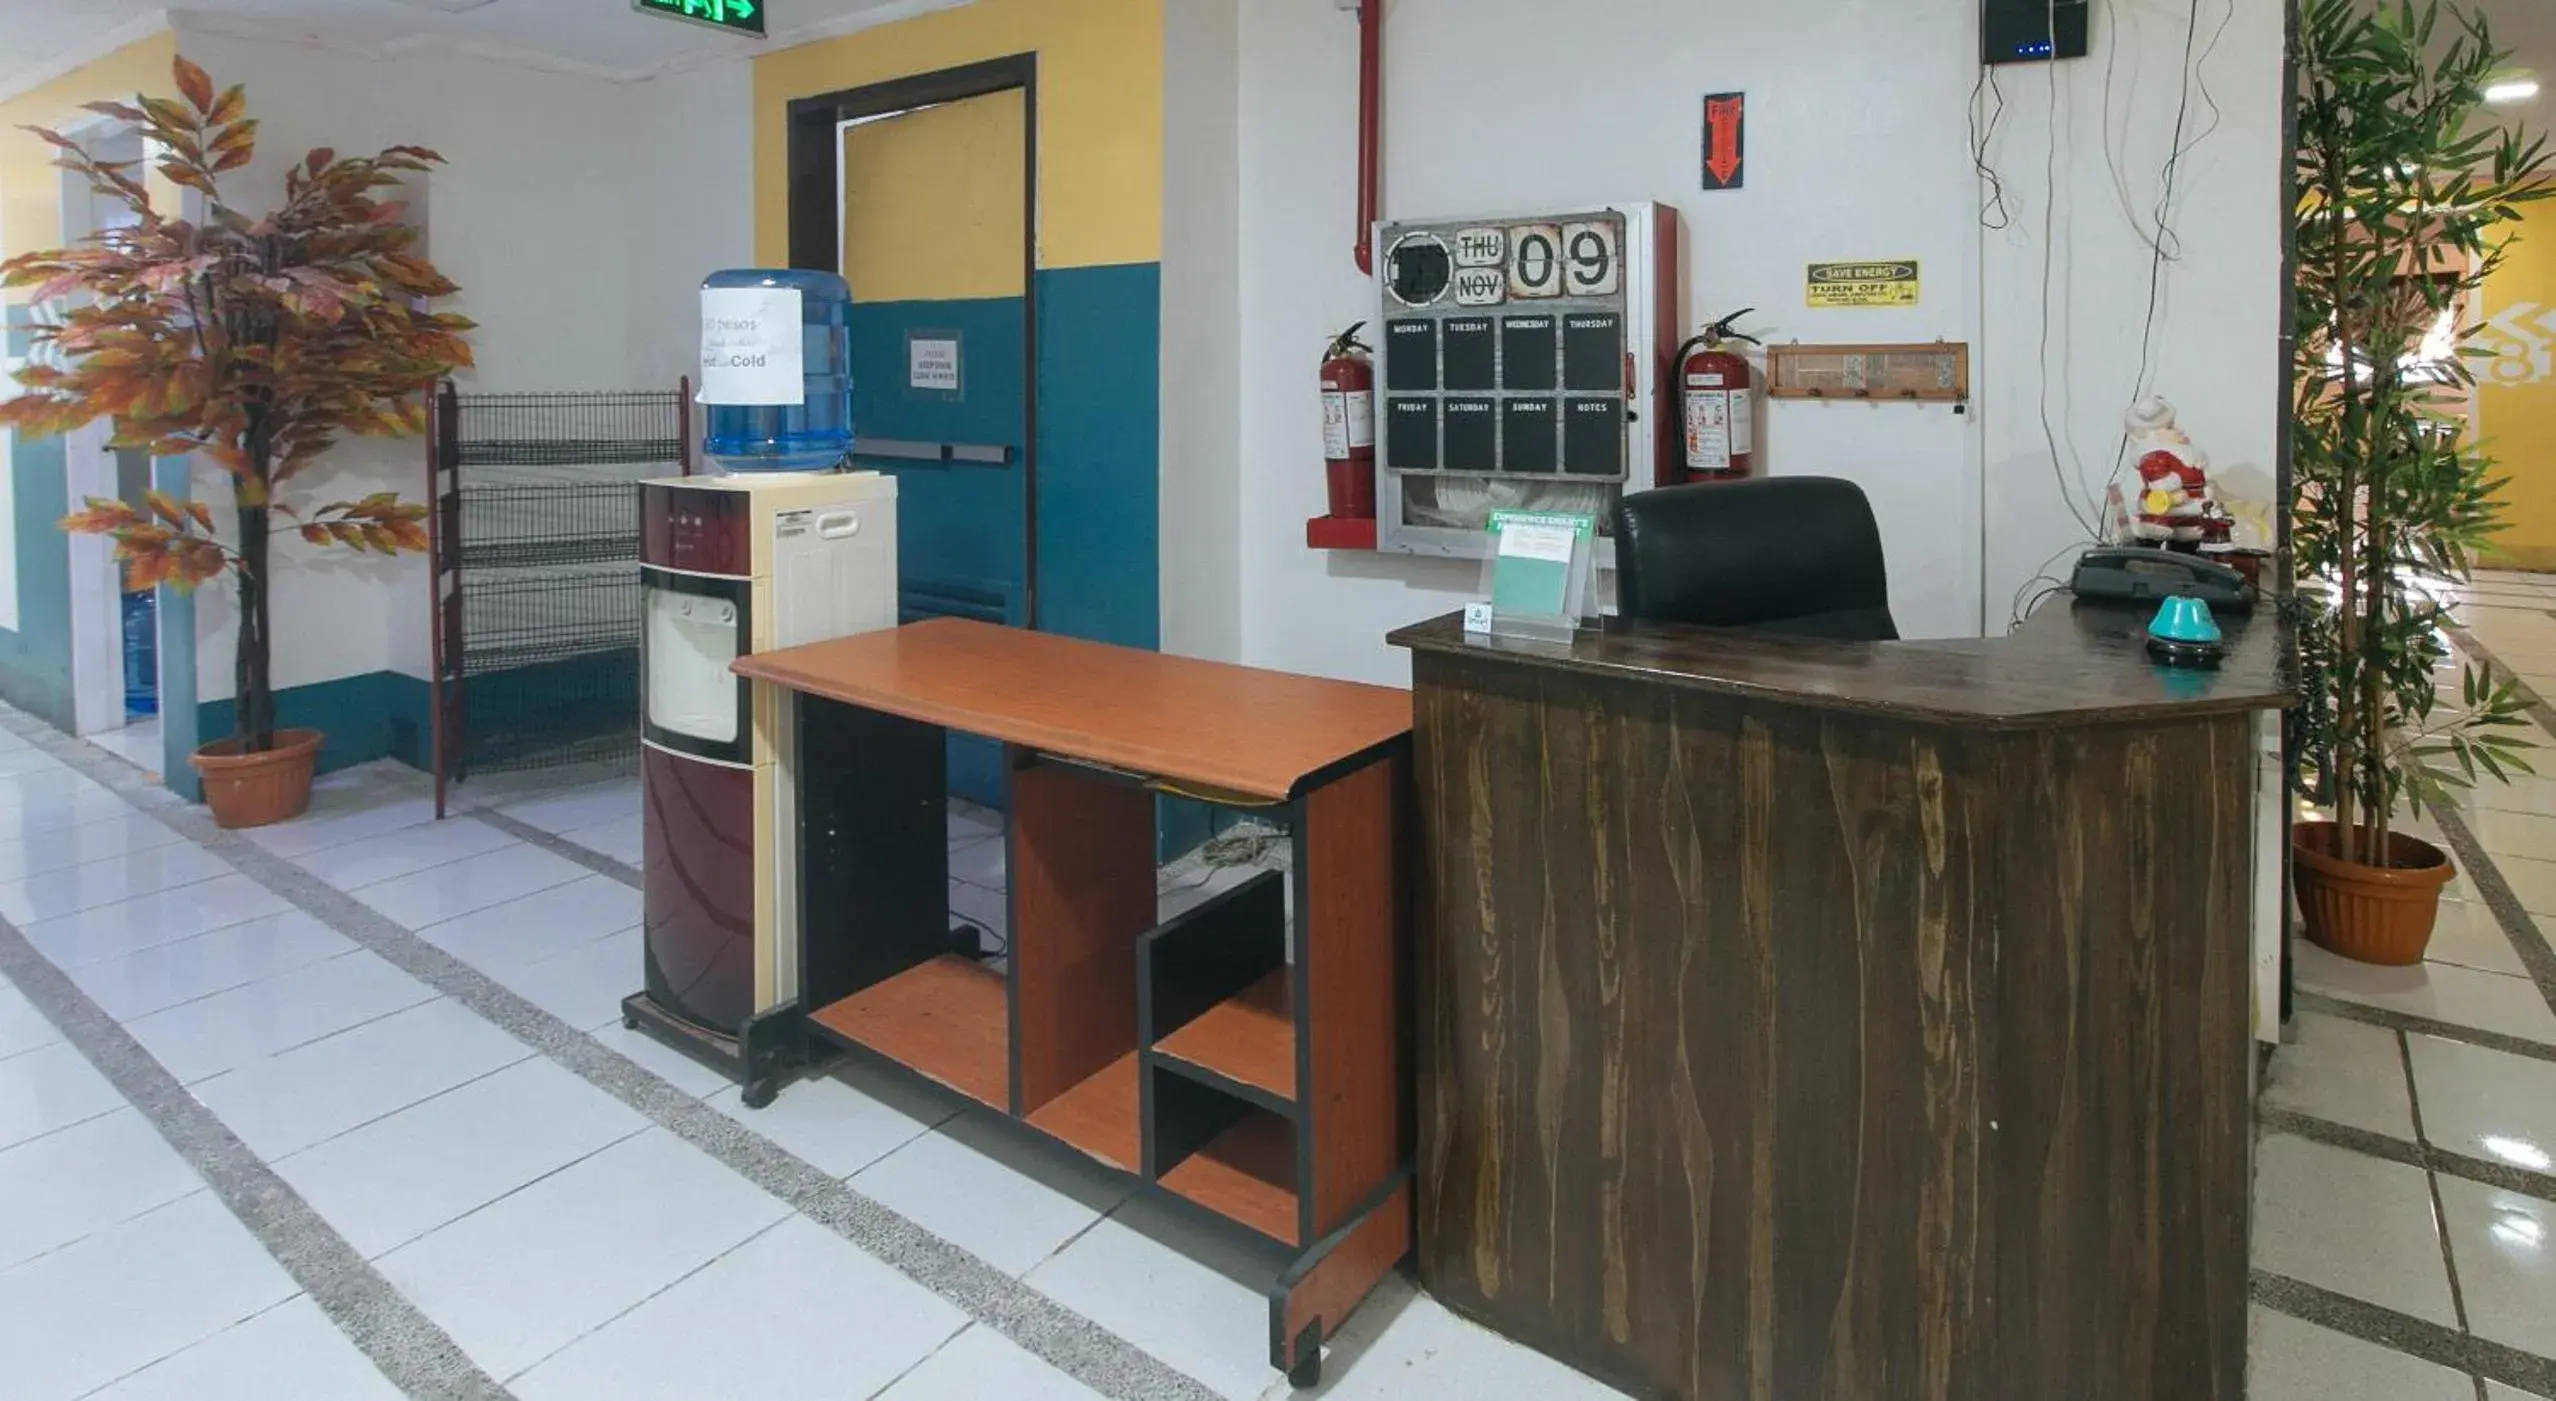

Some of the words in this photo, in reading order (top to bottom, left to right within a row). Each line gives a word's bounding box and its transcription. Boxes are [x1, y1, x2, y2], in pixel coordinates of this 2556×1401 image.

[1461, 235, 1499, 258] THU
[1826, 267, 1852, 279] SAVE
[1855, 265, 1896, 279] ENERGY
[1460, 275, 1499, 296] NOV
[1811, 285, 1854, 293] TURN
[1859, 284, 1888, 293] OFF
[1450, 323, 1488, 332] TUESDAY
[1506, 320, 1549, 329] WEDNESDAY
[1570, 319, 1613, 328] THURSDAY
[1394, 324, 1428, 333] MONDAY
[731, 354, 766, 368] Cold
[1398, 403, 1427, 412] FRIDAY
[1449, 403, 1489, 412] SATURDAY
[1512, 402, 1547, 412] SUNDAY
[1577, 402, 1608, 412] NOTES
